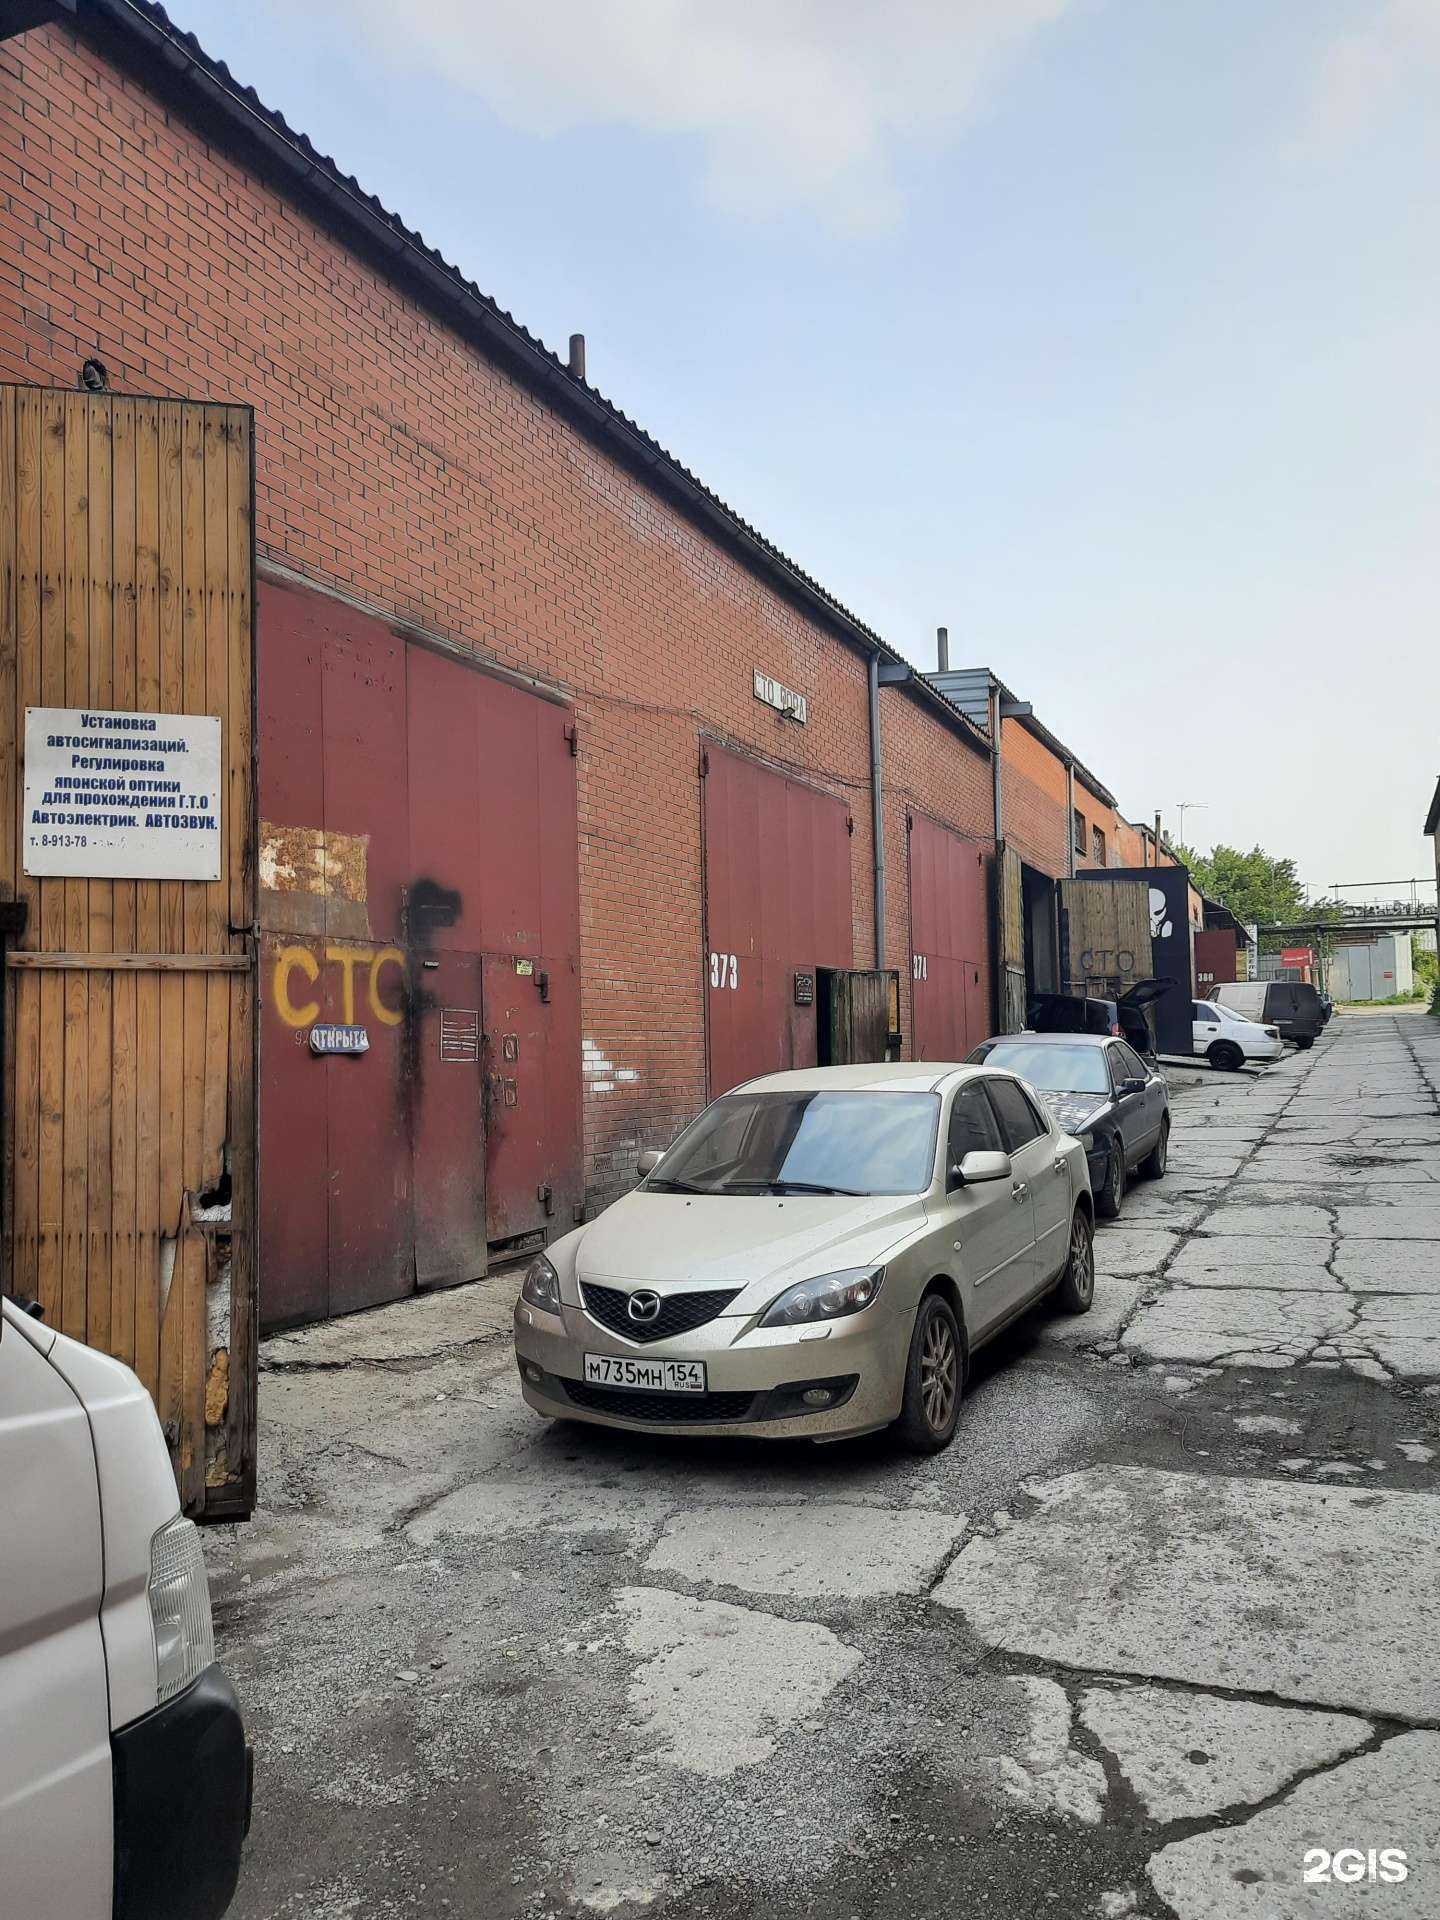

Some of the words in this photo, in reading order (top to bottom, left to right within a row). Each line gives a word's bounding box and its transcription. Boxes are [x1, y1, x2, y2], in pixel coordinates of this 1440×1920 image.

[80, 713, 157, 731] Установка
[46, 734, 190, 754] автосигнализаций.
[71, 754, 165, 772] Регулировка
[54, 775, 126, 791] японской
[128, 779, 181, 793] оптики
[41, 791, 70, 805] для
[74, 792, 176, 809] прохождения
[178, 794, 209, 809] Г.Т.О
[31, 809, 140, 828] Автоэлектрик.
[144, 813, 218, 831] АВТОЗВУК.
[913, 955, 928, 981] 374
[1080, 948, 1135, 972] СТО
[711, 952, 738, 990] 373
[311, 1028, 369, 1049] ОТКРЫТО
[589, 1359, 662, 1386] М735МН
[667, 1364, 699, 1382] 154
[674, 1381, 690, 1389] RUS
